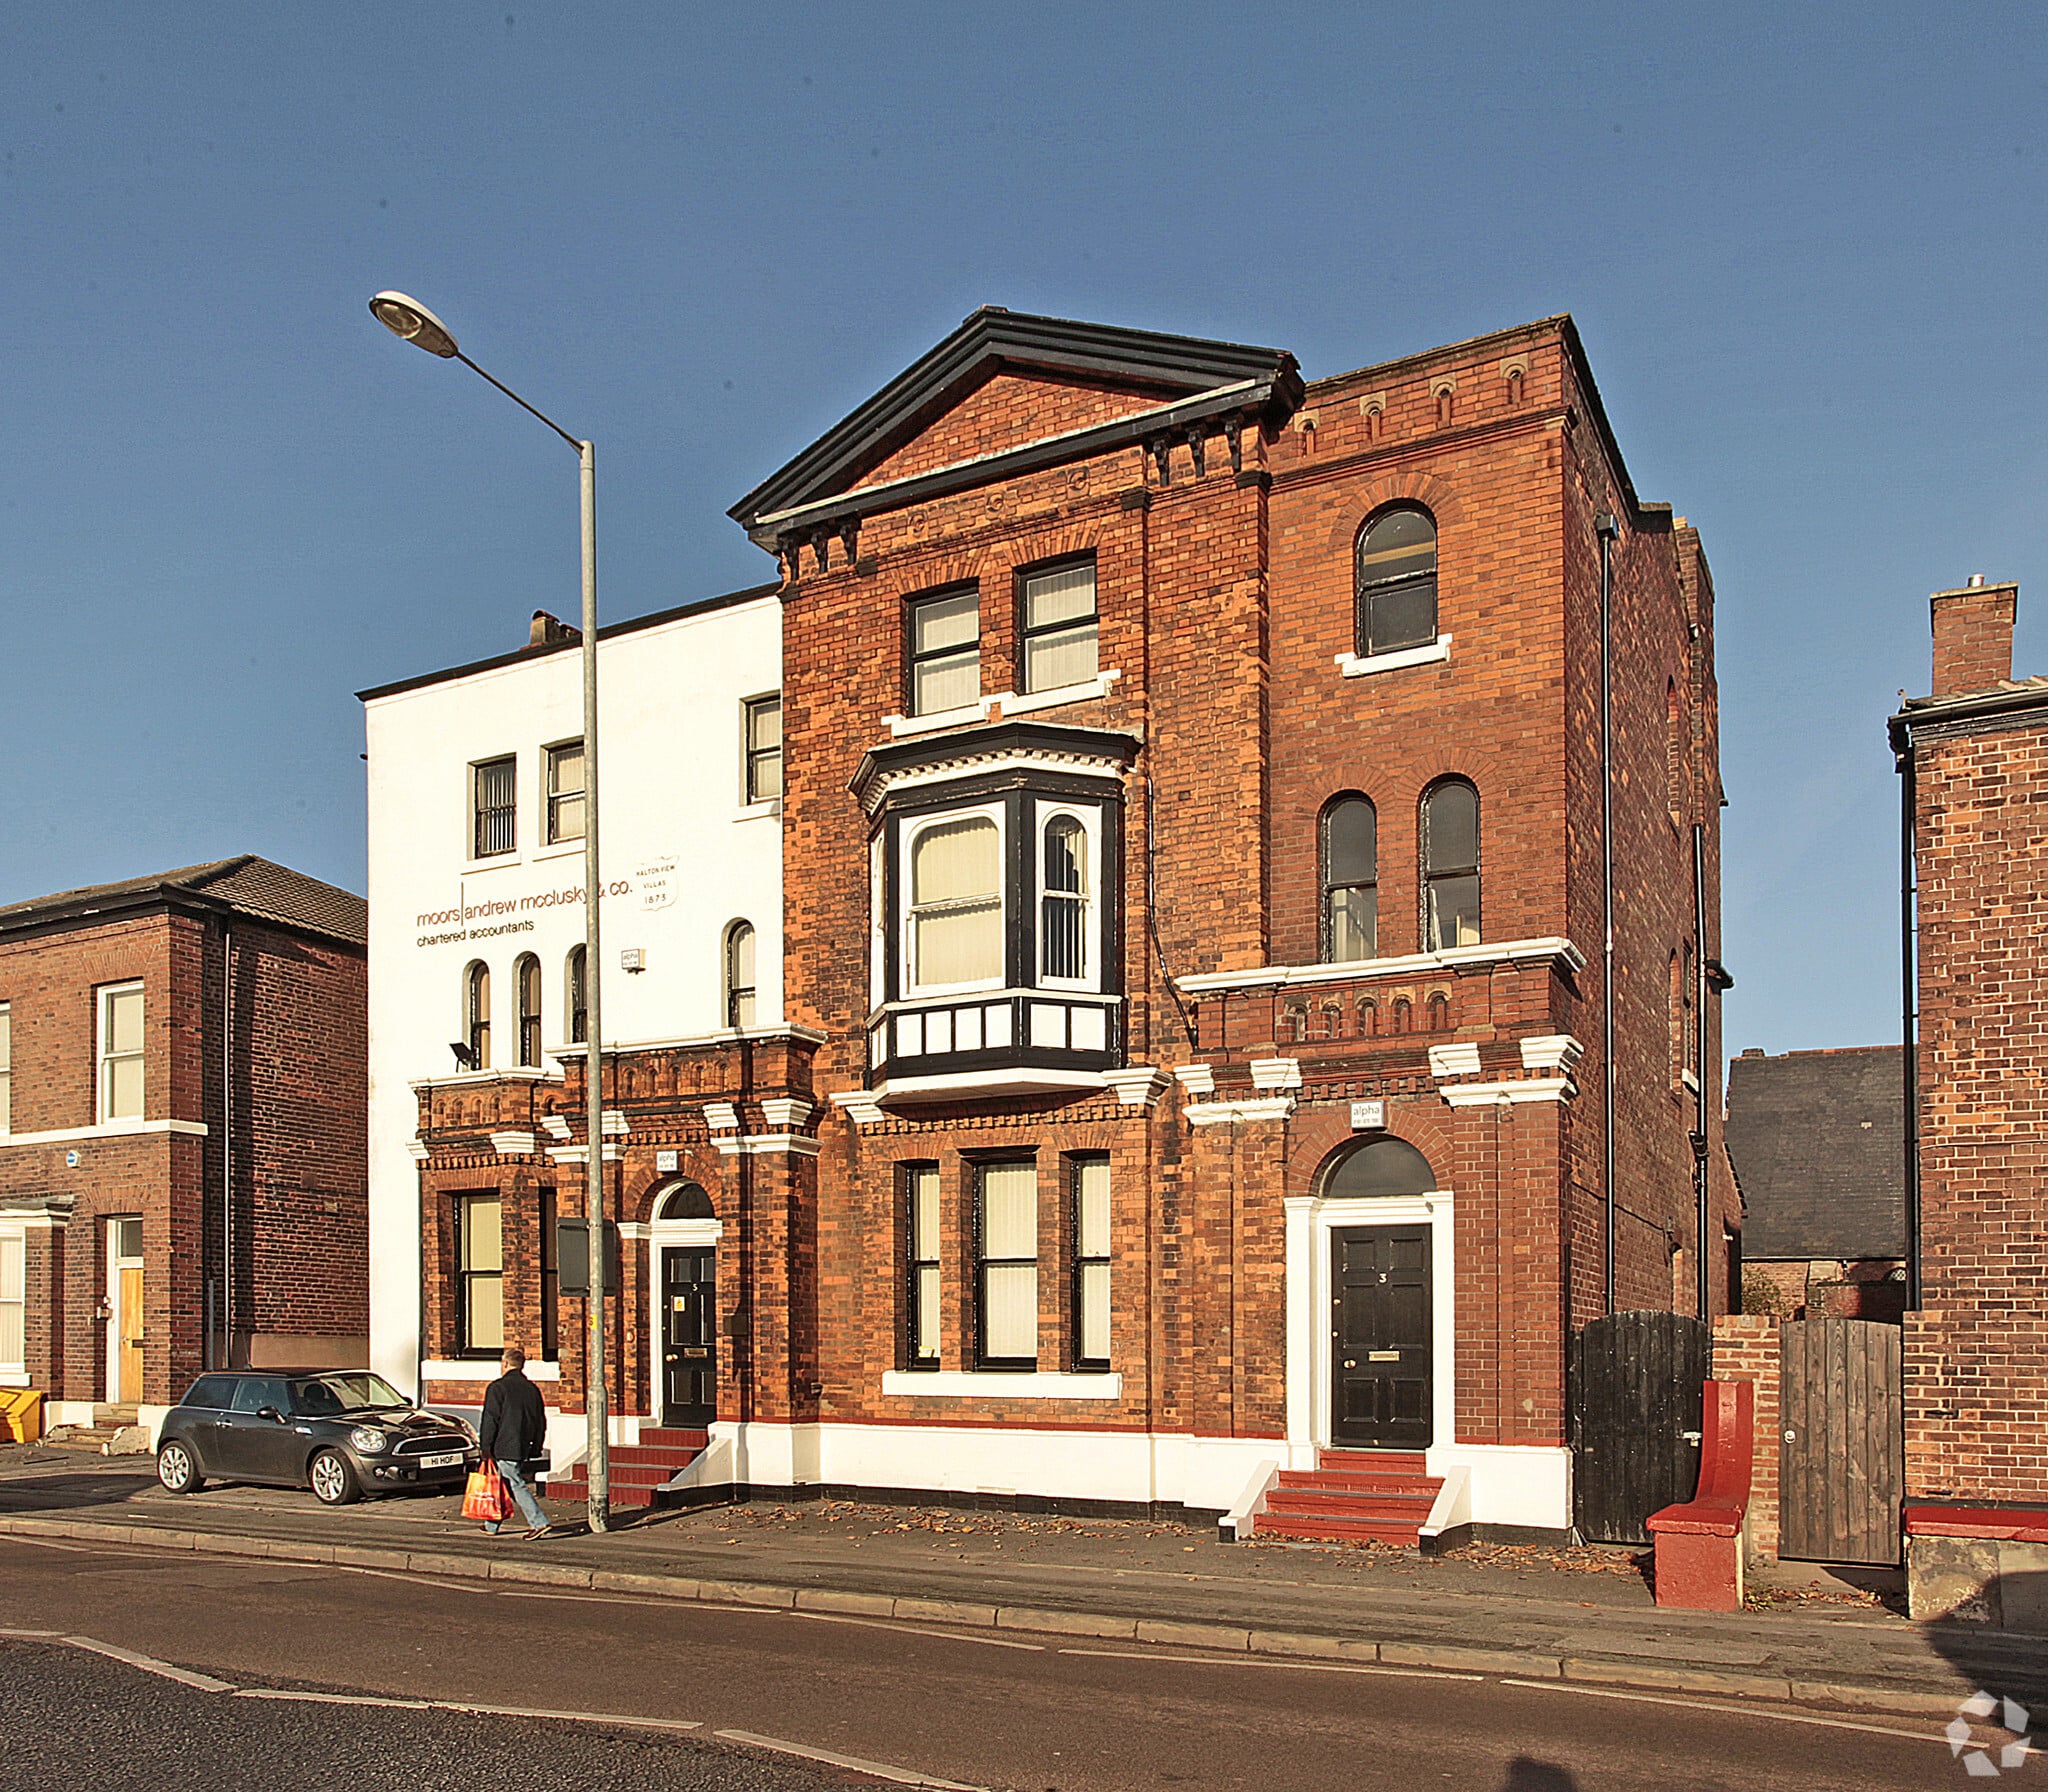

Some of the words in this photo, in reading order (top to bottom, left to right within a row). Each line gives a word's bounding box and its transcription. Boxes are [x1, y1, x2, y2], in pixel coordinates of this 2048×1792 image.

[643, 880, 666, 888] VILLAS
[416, 908, 460, 927] moors
[464, 899, 517, 920] andrew
[520, 885, 588, 911] mcclusky
[609, 880, 633, 896] co.
[644, 893, 666, 904] 1873
[416, 928, 467, 948] chartered
[469, 919, 535, 940] accountants
[1353, 1104, 1380, 1118] alpha
[1379, 1273, 1387, 1283] 3
